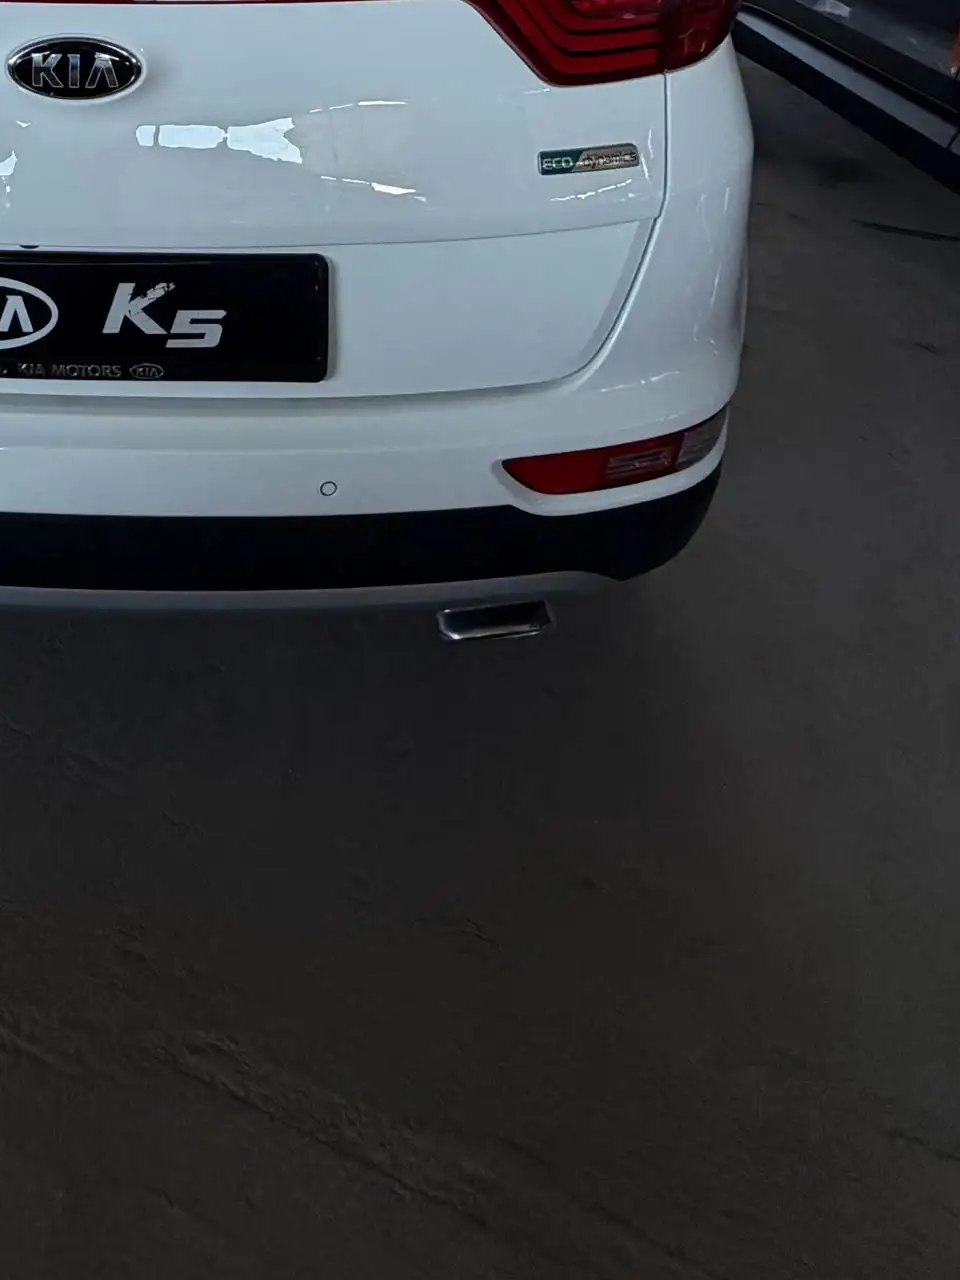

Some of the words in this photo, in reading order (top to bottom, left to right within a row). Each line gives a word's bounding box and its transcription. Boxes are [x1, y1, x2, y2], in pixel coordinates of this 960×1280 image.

[31, 51, 120, 89] KIA
[102, 282, 227, 349] K5
[51, 364, 123, 378] MOTORS
